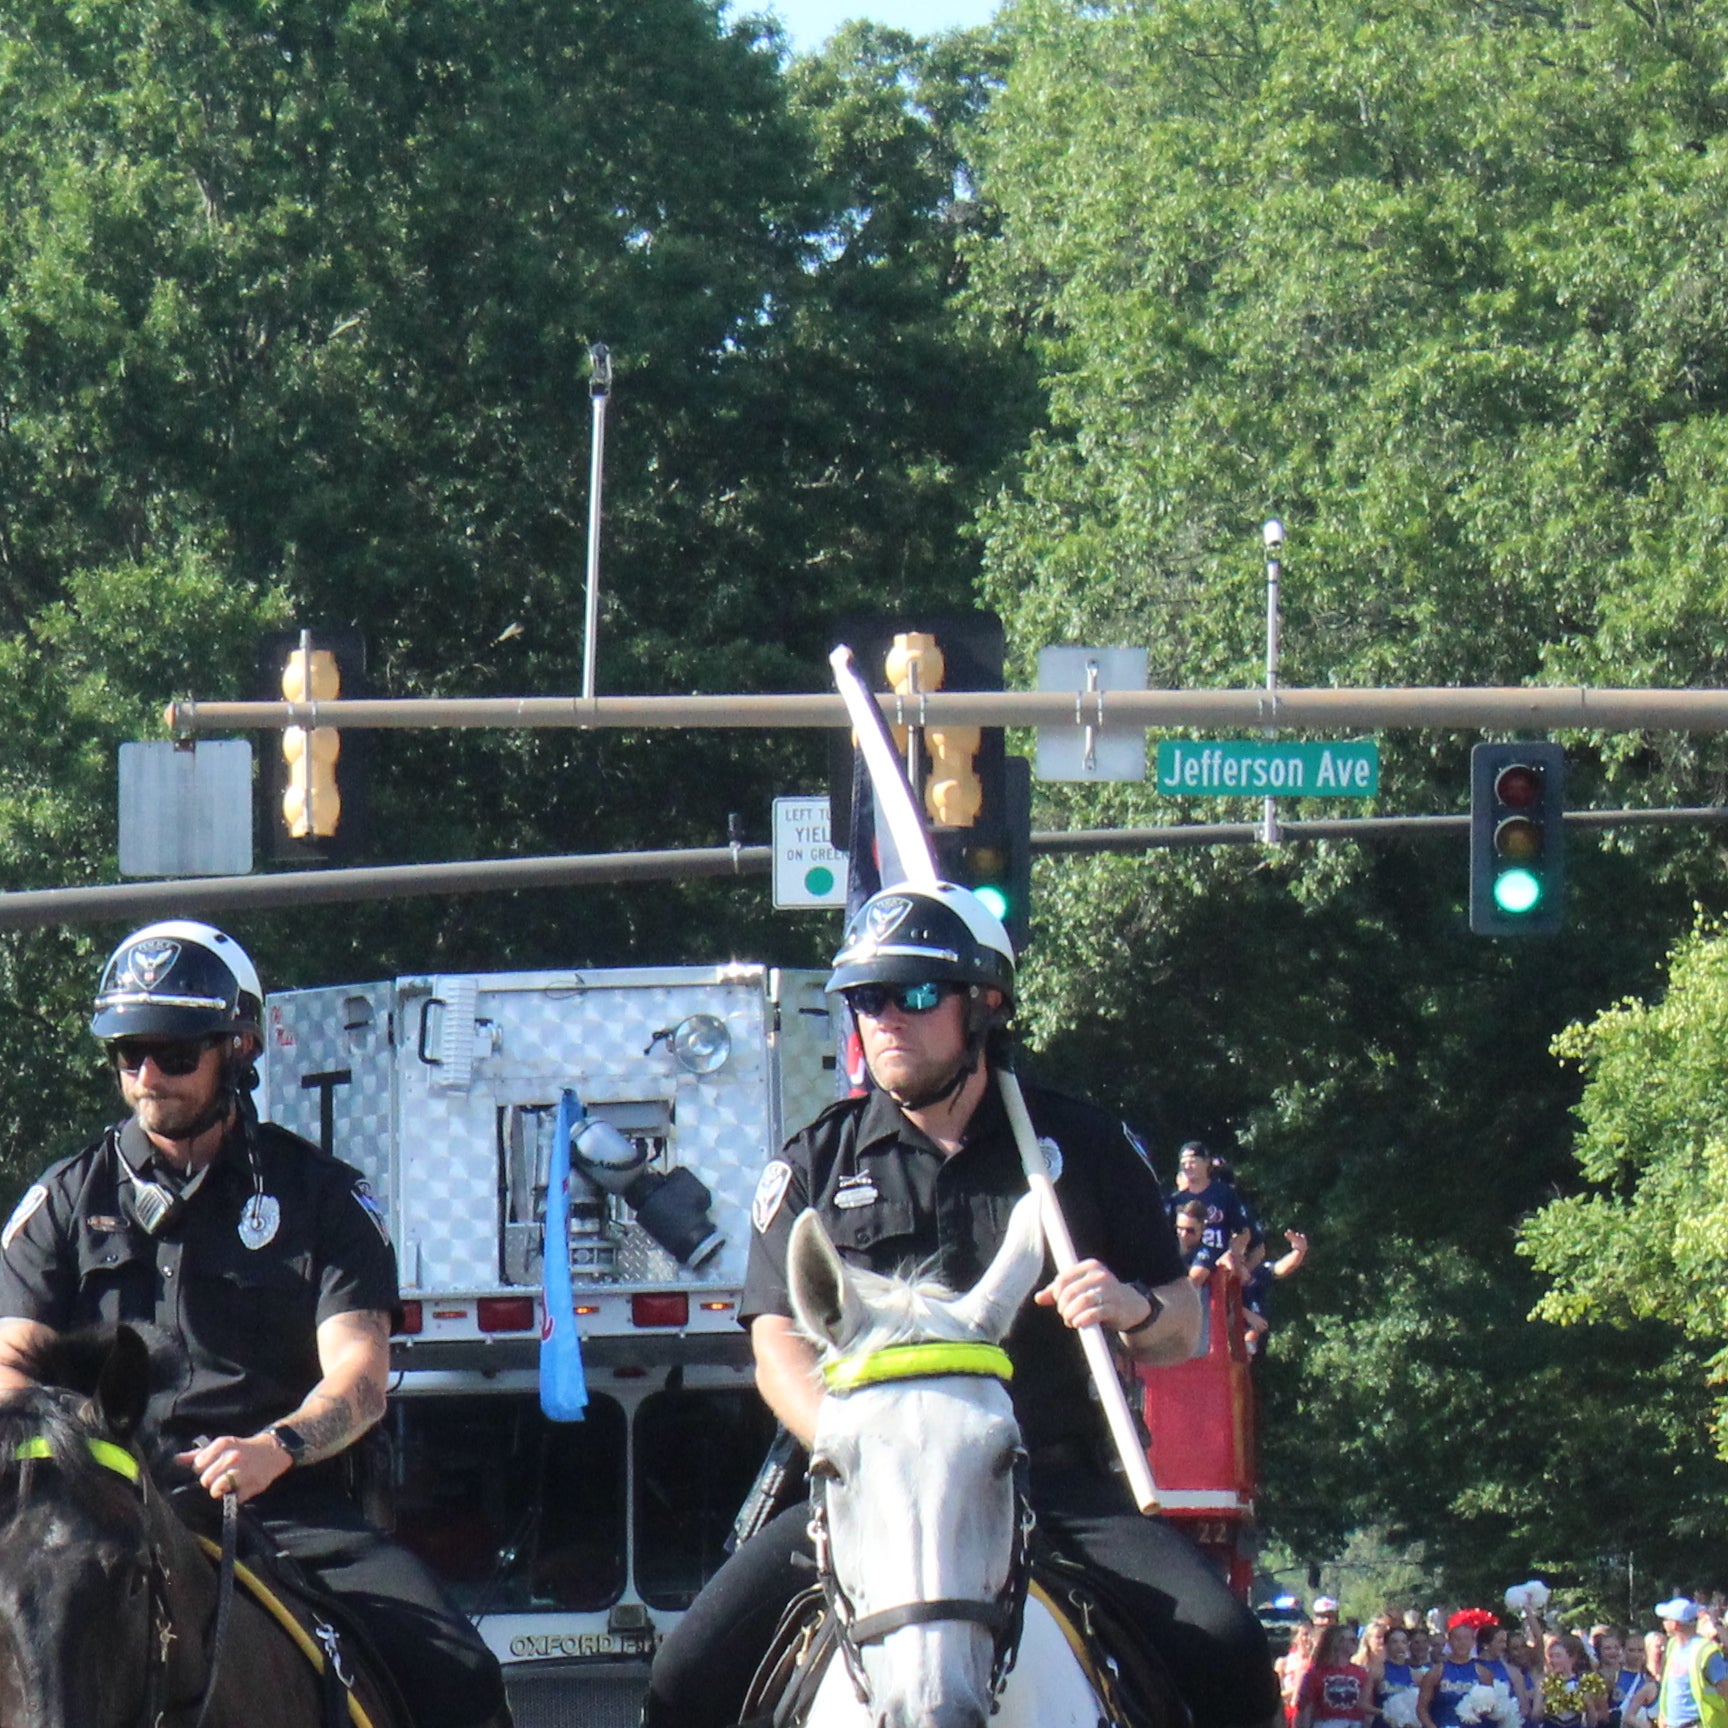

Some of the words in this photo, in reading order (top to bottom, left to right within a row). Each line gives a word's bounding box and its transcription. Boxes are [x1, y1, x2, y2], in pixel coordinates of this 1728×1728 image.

[1164, 749, 1303, 788] Jefferson
[1316, 749, 1371, 788] Ave
[785, 808, 812, 822] LEFT
[795, 827, 831, 843] YIEL
[787, 850, 803, 861] ON
[1201, 1227, 1224, 1249] 21
[1199, 1521, 1228, 1544] 22
[509, 1633, 616, 1657] OXFORD
